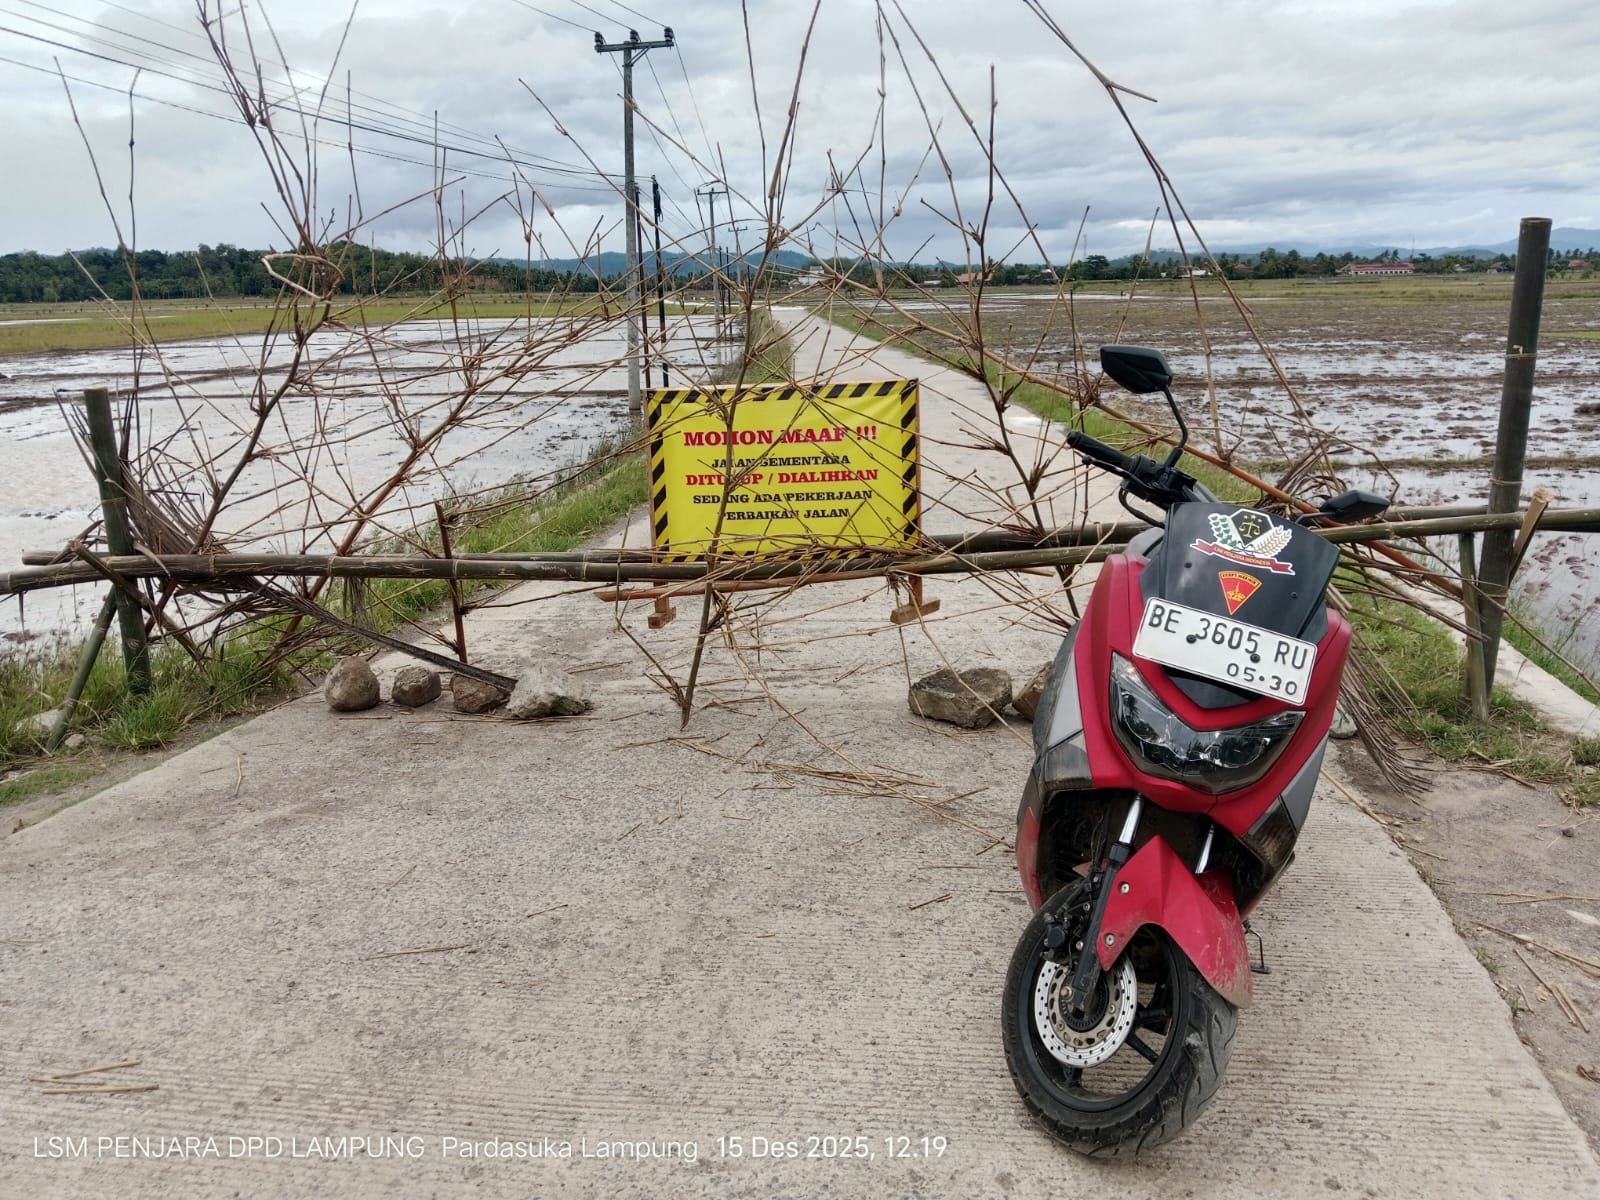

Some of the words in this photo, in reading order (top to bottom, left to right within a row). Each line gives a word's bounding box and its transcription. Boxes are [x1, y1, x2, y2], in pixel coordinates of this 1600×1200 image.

[684, 430, 773, 446] MOHON
[781, 427, 848, 443] MAAF
[856, 426, 877, 440] !!!
[760, 455, 850, 467] SEMENTARA
[686, 473, 763, 486] DITUUP
[768, 473, 774, 485] /
[778, 469, 878, 484] DIALIHKAN
[693, 494, 749, 504] SEDNG
[754, 493, 781, 503] ADA
[786, 490, 872, 502] PEKERJAAN
[716, 510, 799, 520] ERBAIKAN
[804, 508, 849, 518] JALAN
[1148, 604, 1182, 634] BE
[1195, 617, 1260, 654] 3605
[1274, 640, 1308, 670] RU
